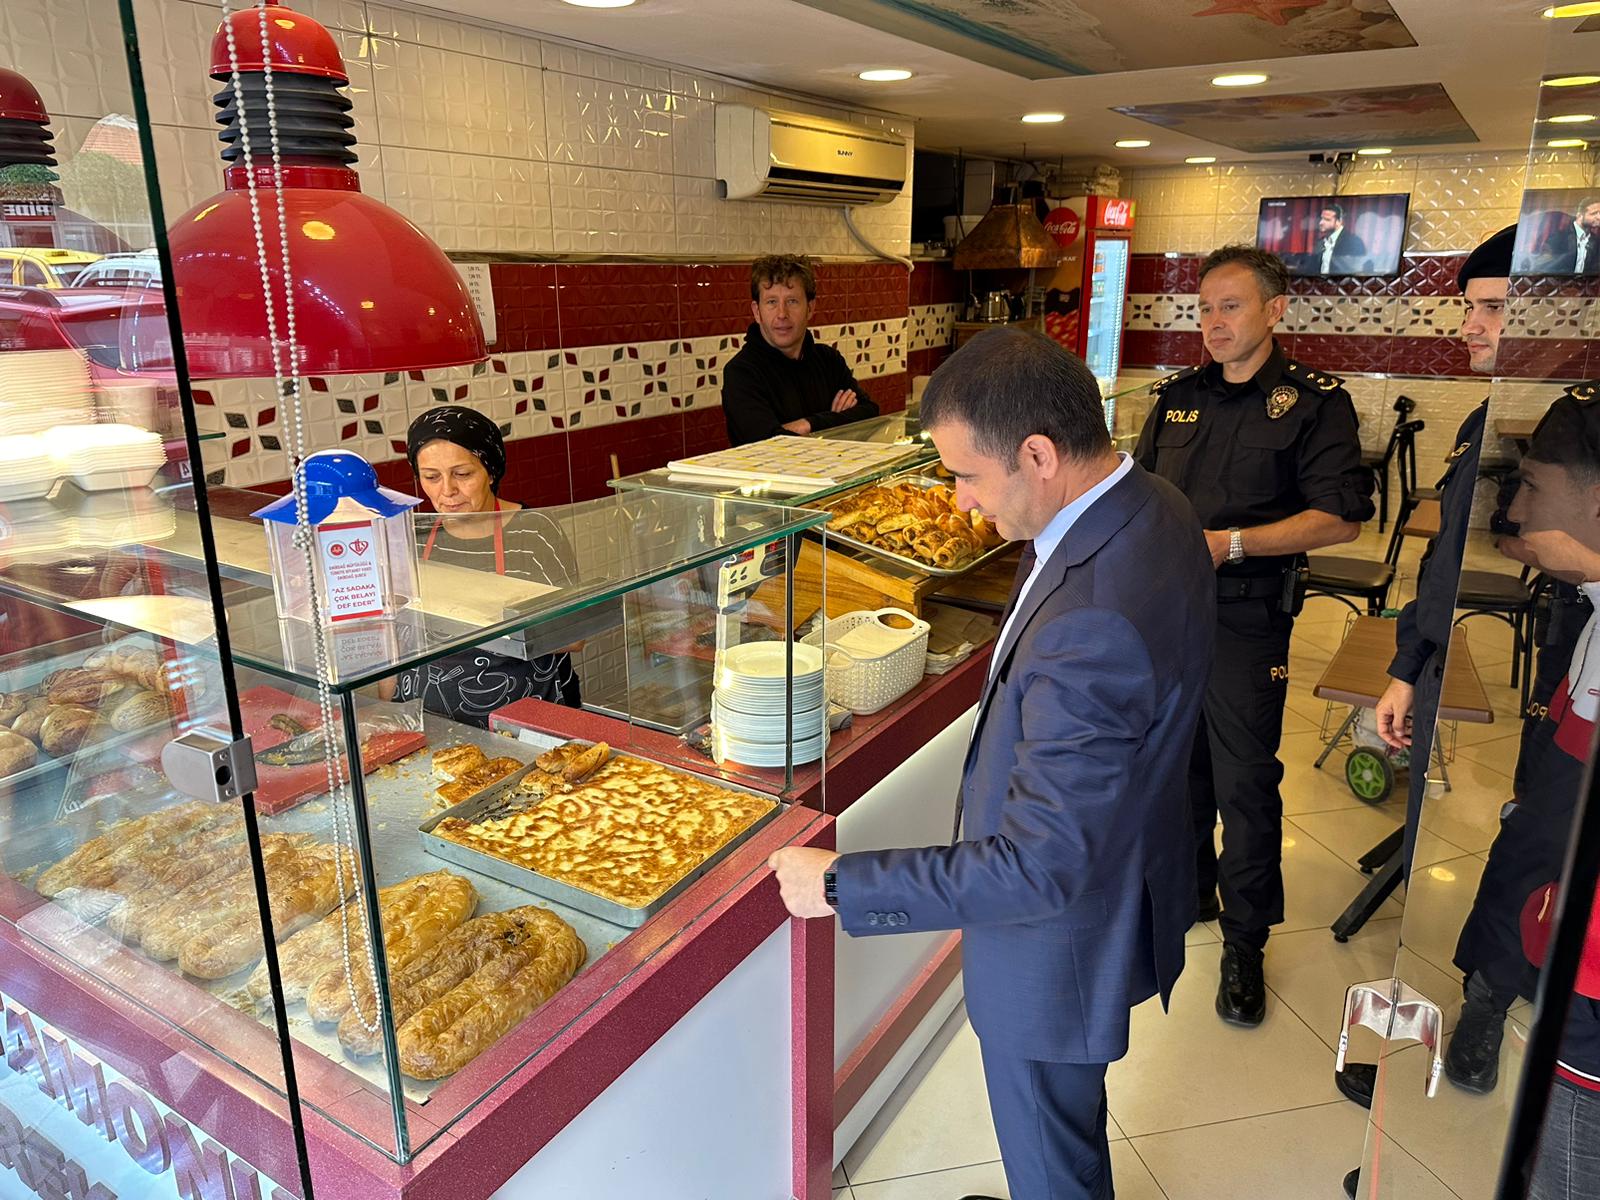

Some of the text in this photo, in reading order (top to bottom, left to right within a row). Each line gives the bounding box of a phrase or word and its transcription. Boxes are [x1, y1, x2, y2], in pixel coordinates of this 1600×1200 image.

[346, 583, 376, 592] SADAKA
[334, 594, 350, 602] ÇOK
[337, 602, 352, 610] DEF
